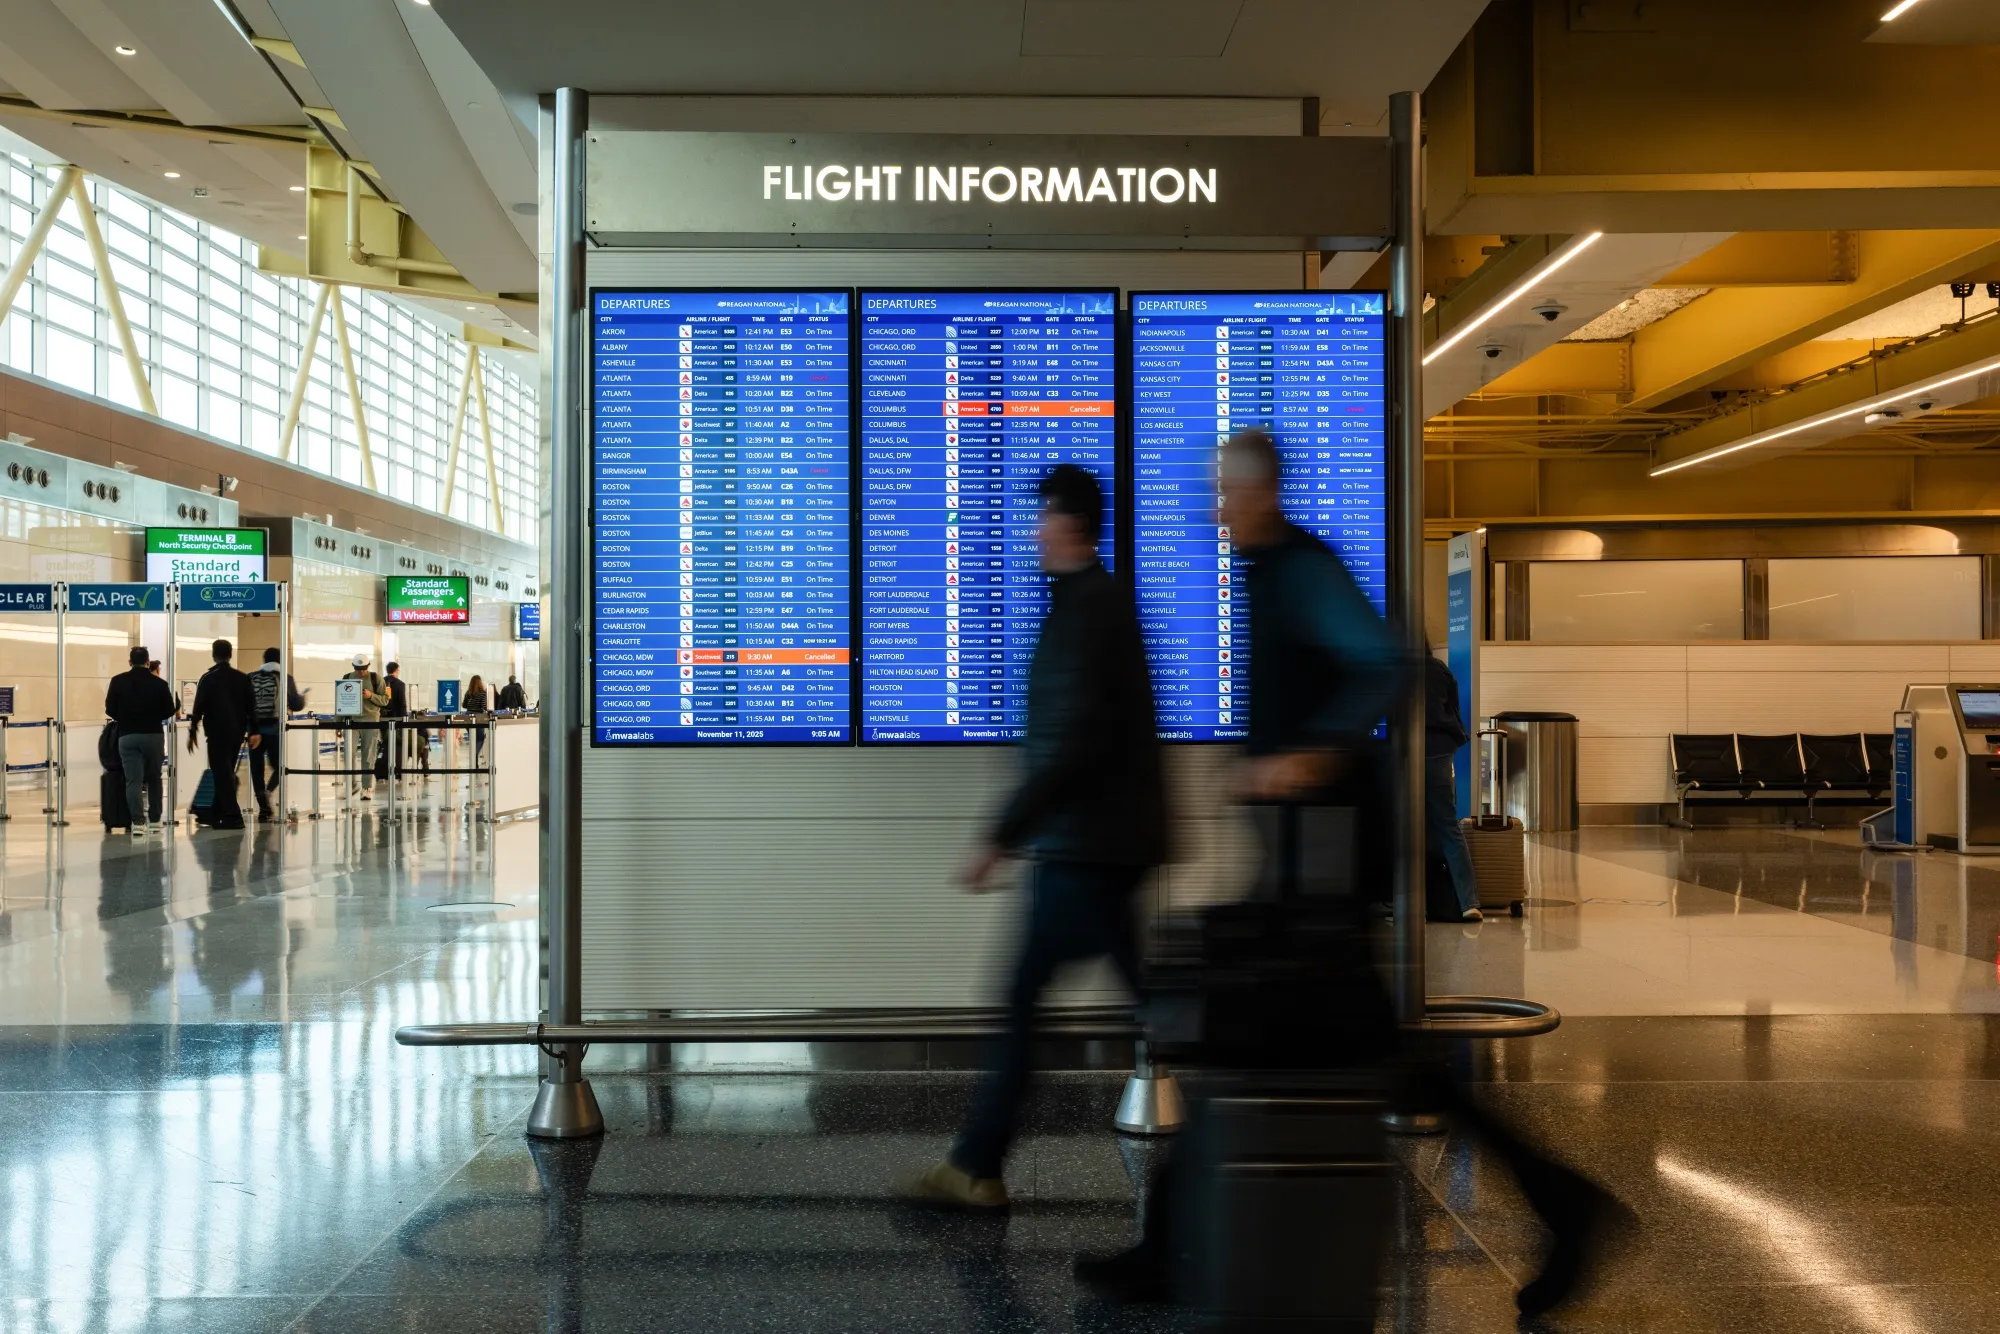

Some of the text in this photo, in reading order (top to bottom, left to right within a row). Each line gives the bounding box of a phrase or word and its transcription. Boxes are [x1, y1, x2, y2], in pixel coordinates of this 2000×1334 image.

[763, 165, 1216, 203] FLIGHT INFORMATION
[601, 299, 671, 309] DEPARTURES
[868, 299, 937, 309] DEPARTURES
[1139, 300, 1208, 311] DEPARTURES
[177, 533, 224, 543] TERMINAL
[158, 541, 253, 551] North Security Checkpoint
[171, 559, 240, 572] Standard
[172, 571, 240, 583] Entrance
[406, 579, 449, 588] Standard
[401, 587, 455, 598] Passengers
[78, 592, 136, 606] TSA Pre
[403, 610, 454, 620] Wheelchair
[611, 731, 654, 740] mwaalabs
[734, 731, 745, 739] 11,
[878, 731, 921, 739] mwaalabs
